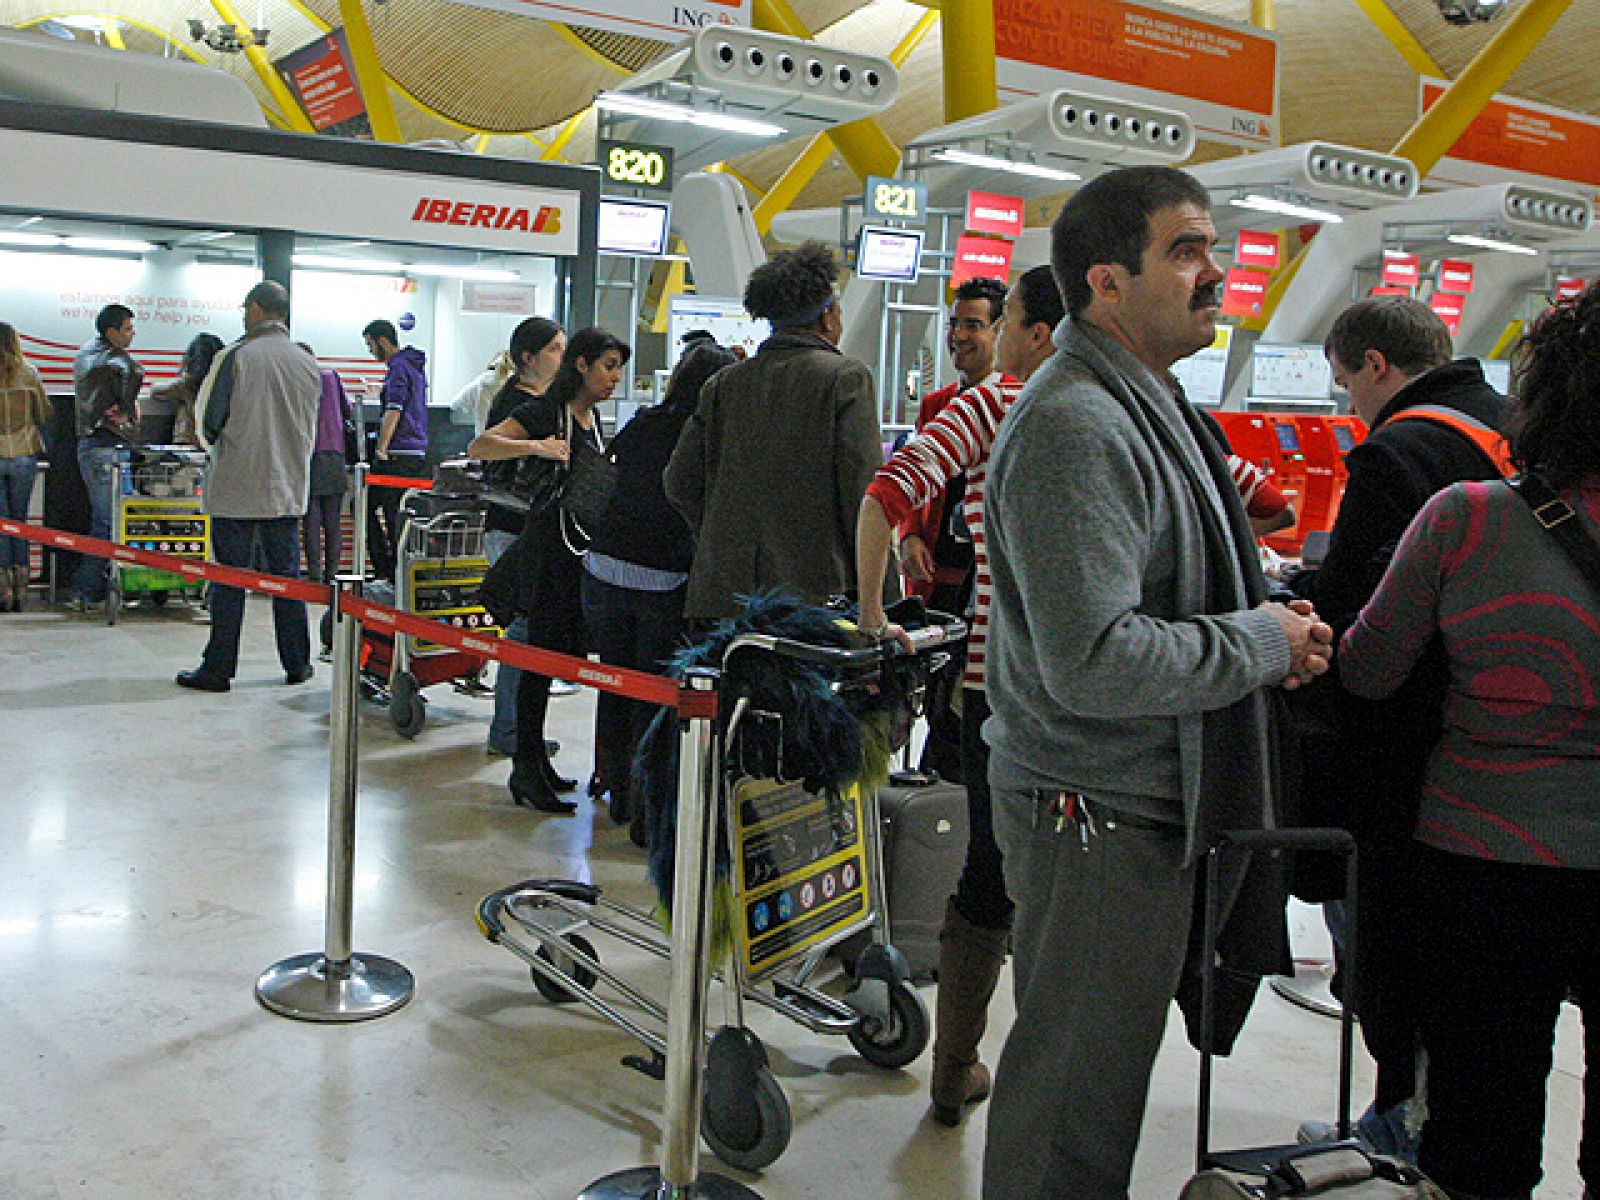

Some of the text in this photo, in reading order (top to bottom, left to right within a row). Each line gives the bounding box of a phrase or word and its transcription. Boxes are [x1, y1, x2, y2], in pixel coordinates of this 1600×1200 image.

[673, 7, 713, 27] ING
[1231, 116, 1256, 135] ING
[607, 147, 666, 186] 820
[874, 183, 919, 216] 821
[411, 197, 530, 233] IBERIA
[157, 296, 189, 310] para
[153, 309, 183, 325] help
[187, 314, 210, 327] you
